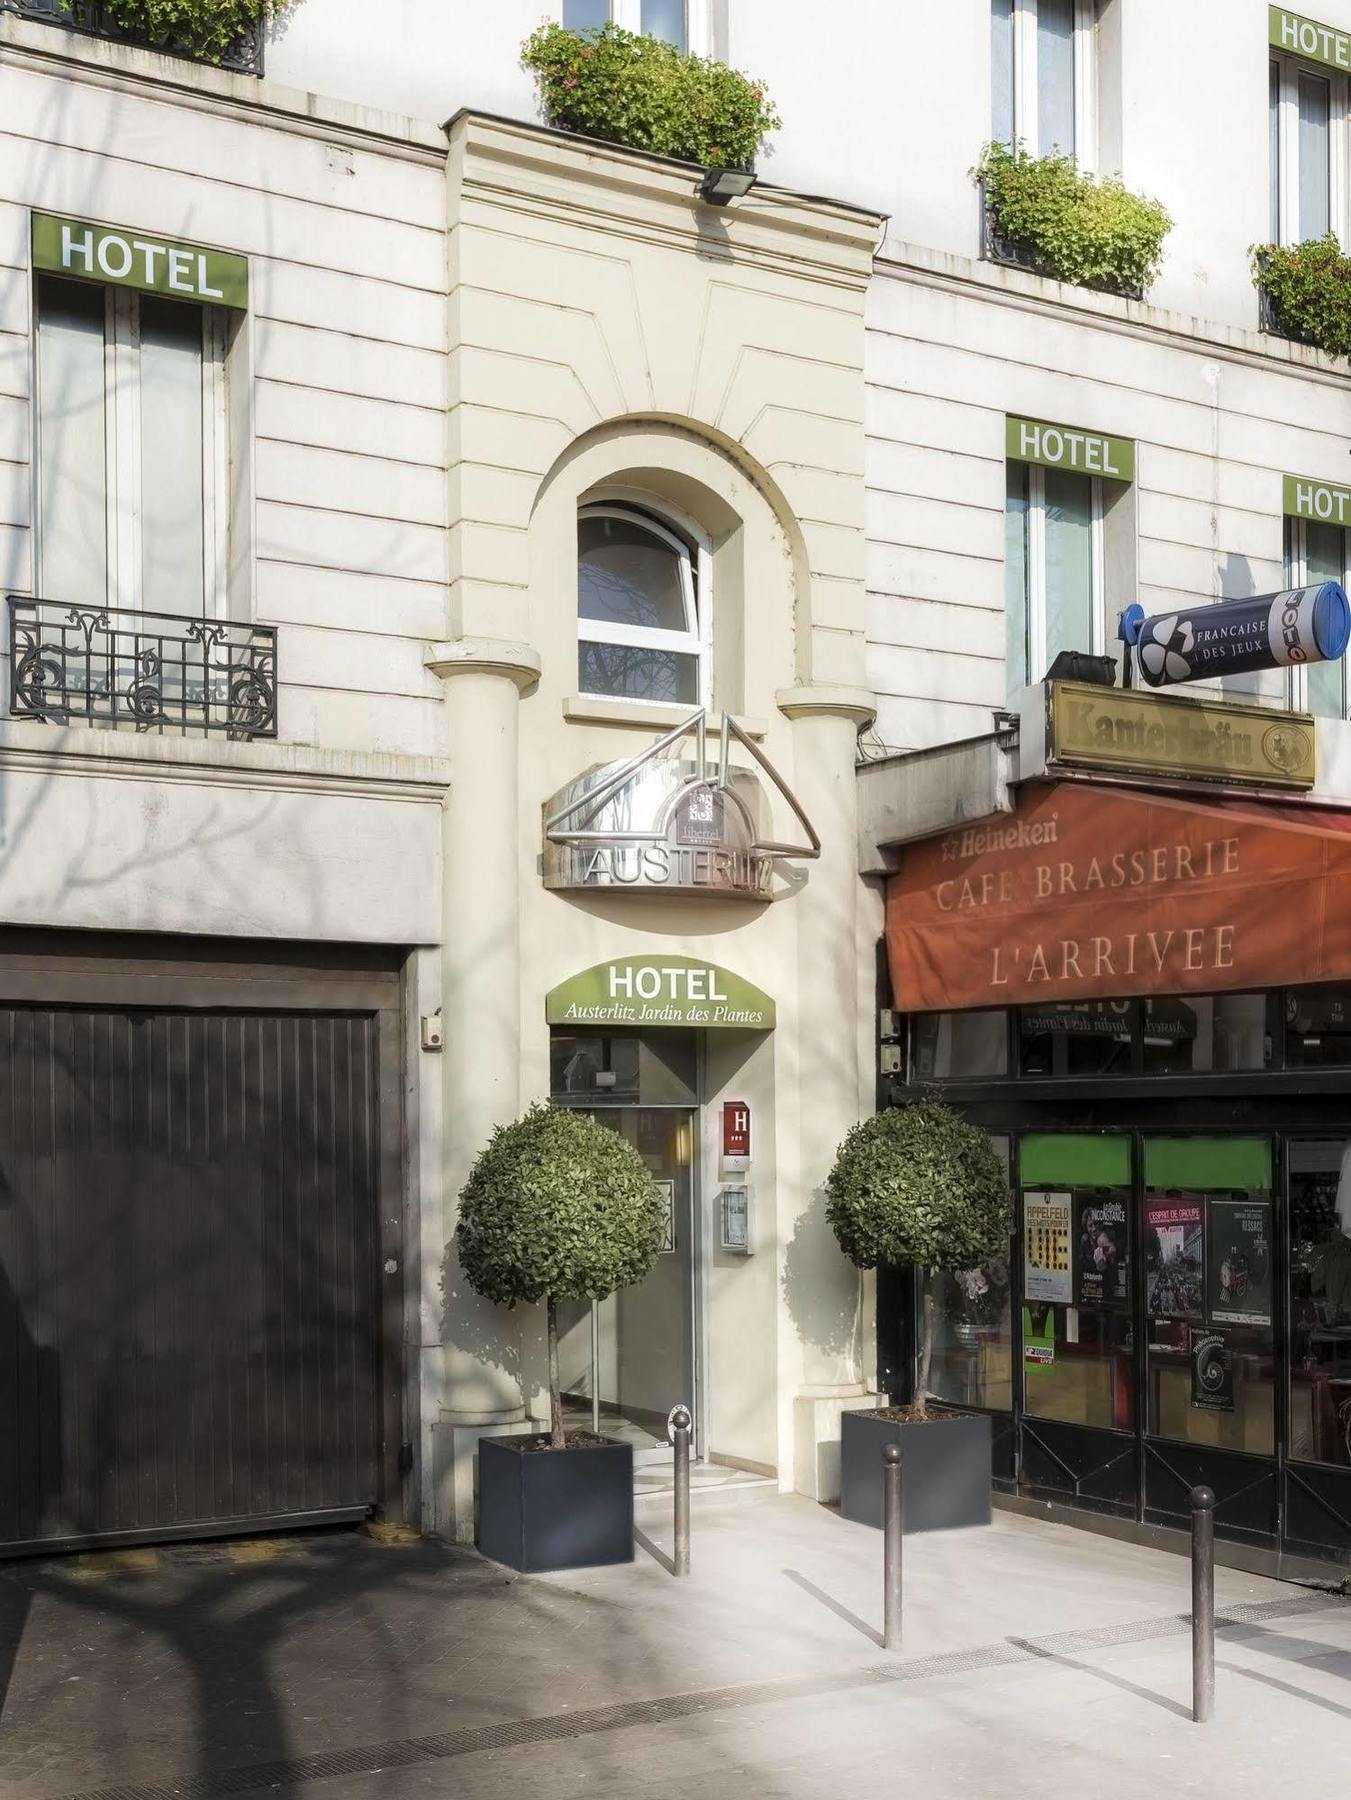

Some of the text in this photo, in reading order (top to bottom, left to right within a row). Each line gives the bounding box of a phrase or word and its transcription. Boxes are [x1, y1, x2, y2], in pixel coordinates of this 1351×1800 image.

[1281, 14, 1349, 67] HOTE
[62, 225, 224, 298] HOTEL
[1020, 423, 1119, 474] HOTEL
[1296, 483, 1350, 521] HOT
[1197, 620, 1267, 643] FRANCAISE
[1280, 591, 1307, 662] LOTO
[1203, 639, 1263, 660] DES JEUX
[959, 819, 1058, 858] Heineken
[1036, 837, 1240, 898] BRASSERIE
[989, 924, 1236, 985] L'ARRIVEE
[609, 966, 728, 1001] HOTEL
[564, 1002, 764, 1024] Austerlitz Jardin des Plantes
[735, 1111, 748, 1132] H
[1027, 1206, 1069, 1220] APPELFELD
